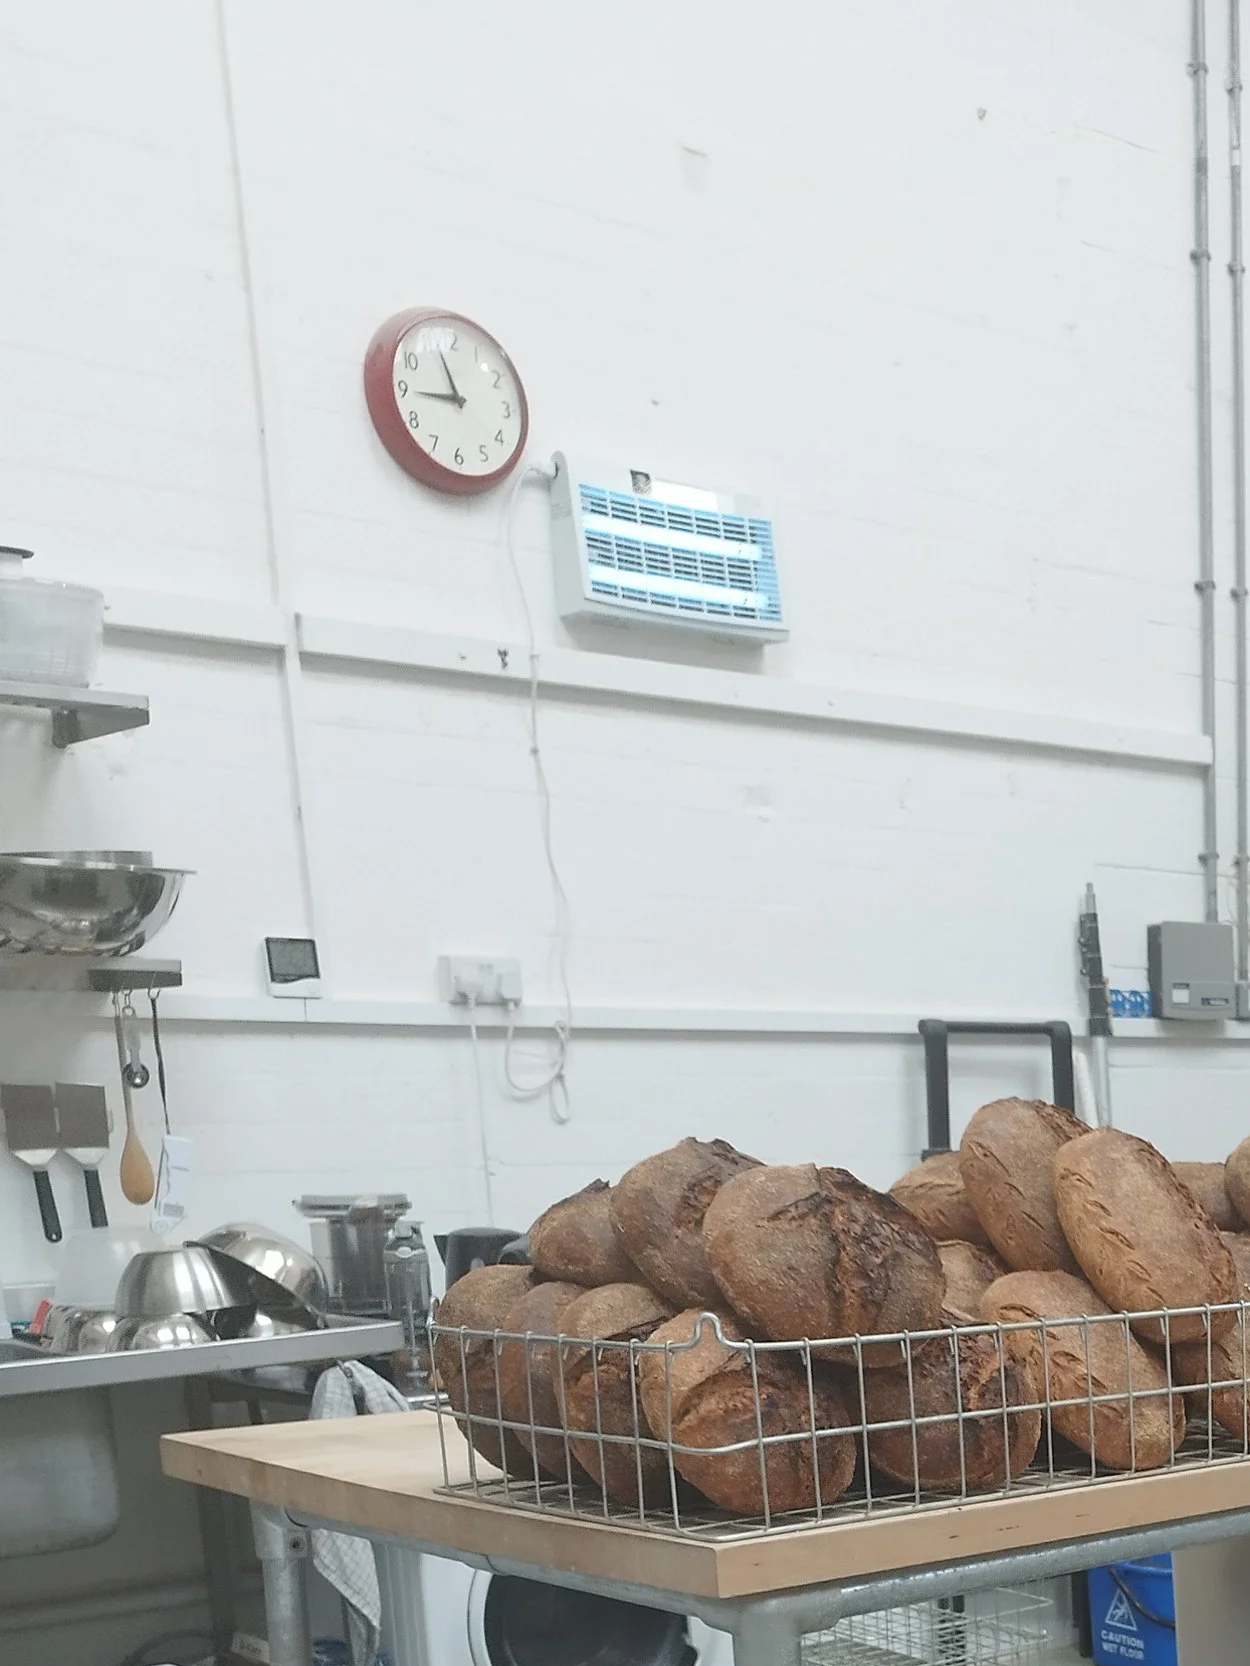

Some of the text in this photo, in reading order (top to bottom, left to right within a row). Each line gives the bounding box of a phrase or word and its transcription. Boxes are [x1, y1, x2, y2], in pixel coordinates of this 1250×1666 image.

[404, 351, 419, 371] 10
[397, 379, 409, 399] 9
[491, 369, 504, 390] 2
[408, 410, 420, 430] 8
[501, 400, 511, 420] 3
[428, 434, 439, 453] 7
[494, 429, 504, 447] 4
[454, 447, 465, 466] 6
[479, 444, 489, 463] 5
[1101, 1630, 1145, 1650] CAUTION
[1102, 1641, 1145, 1660] WET FLOOR
